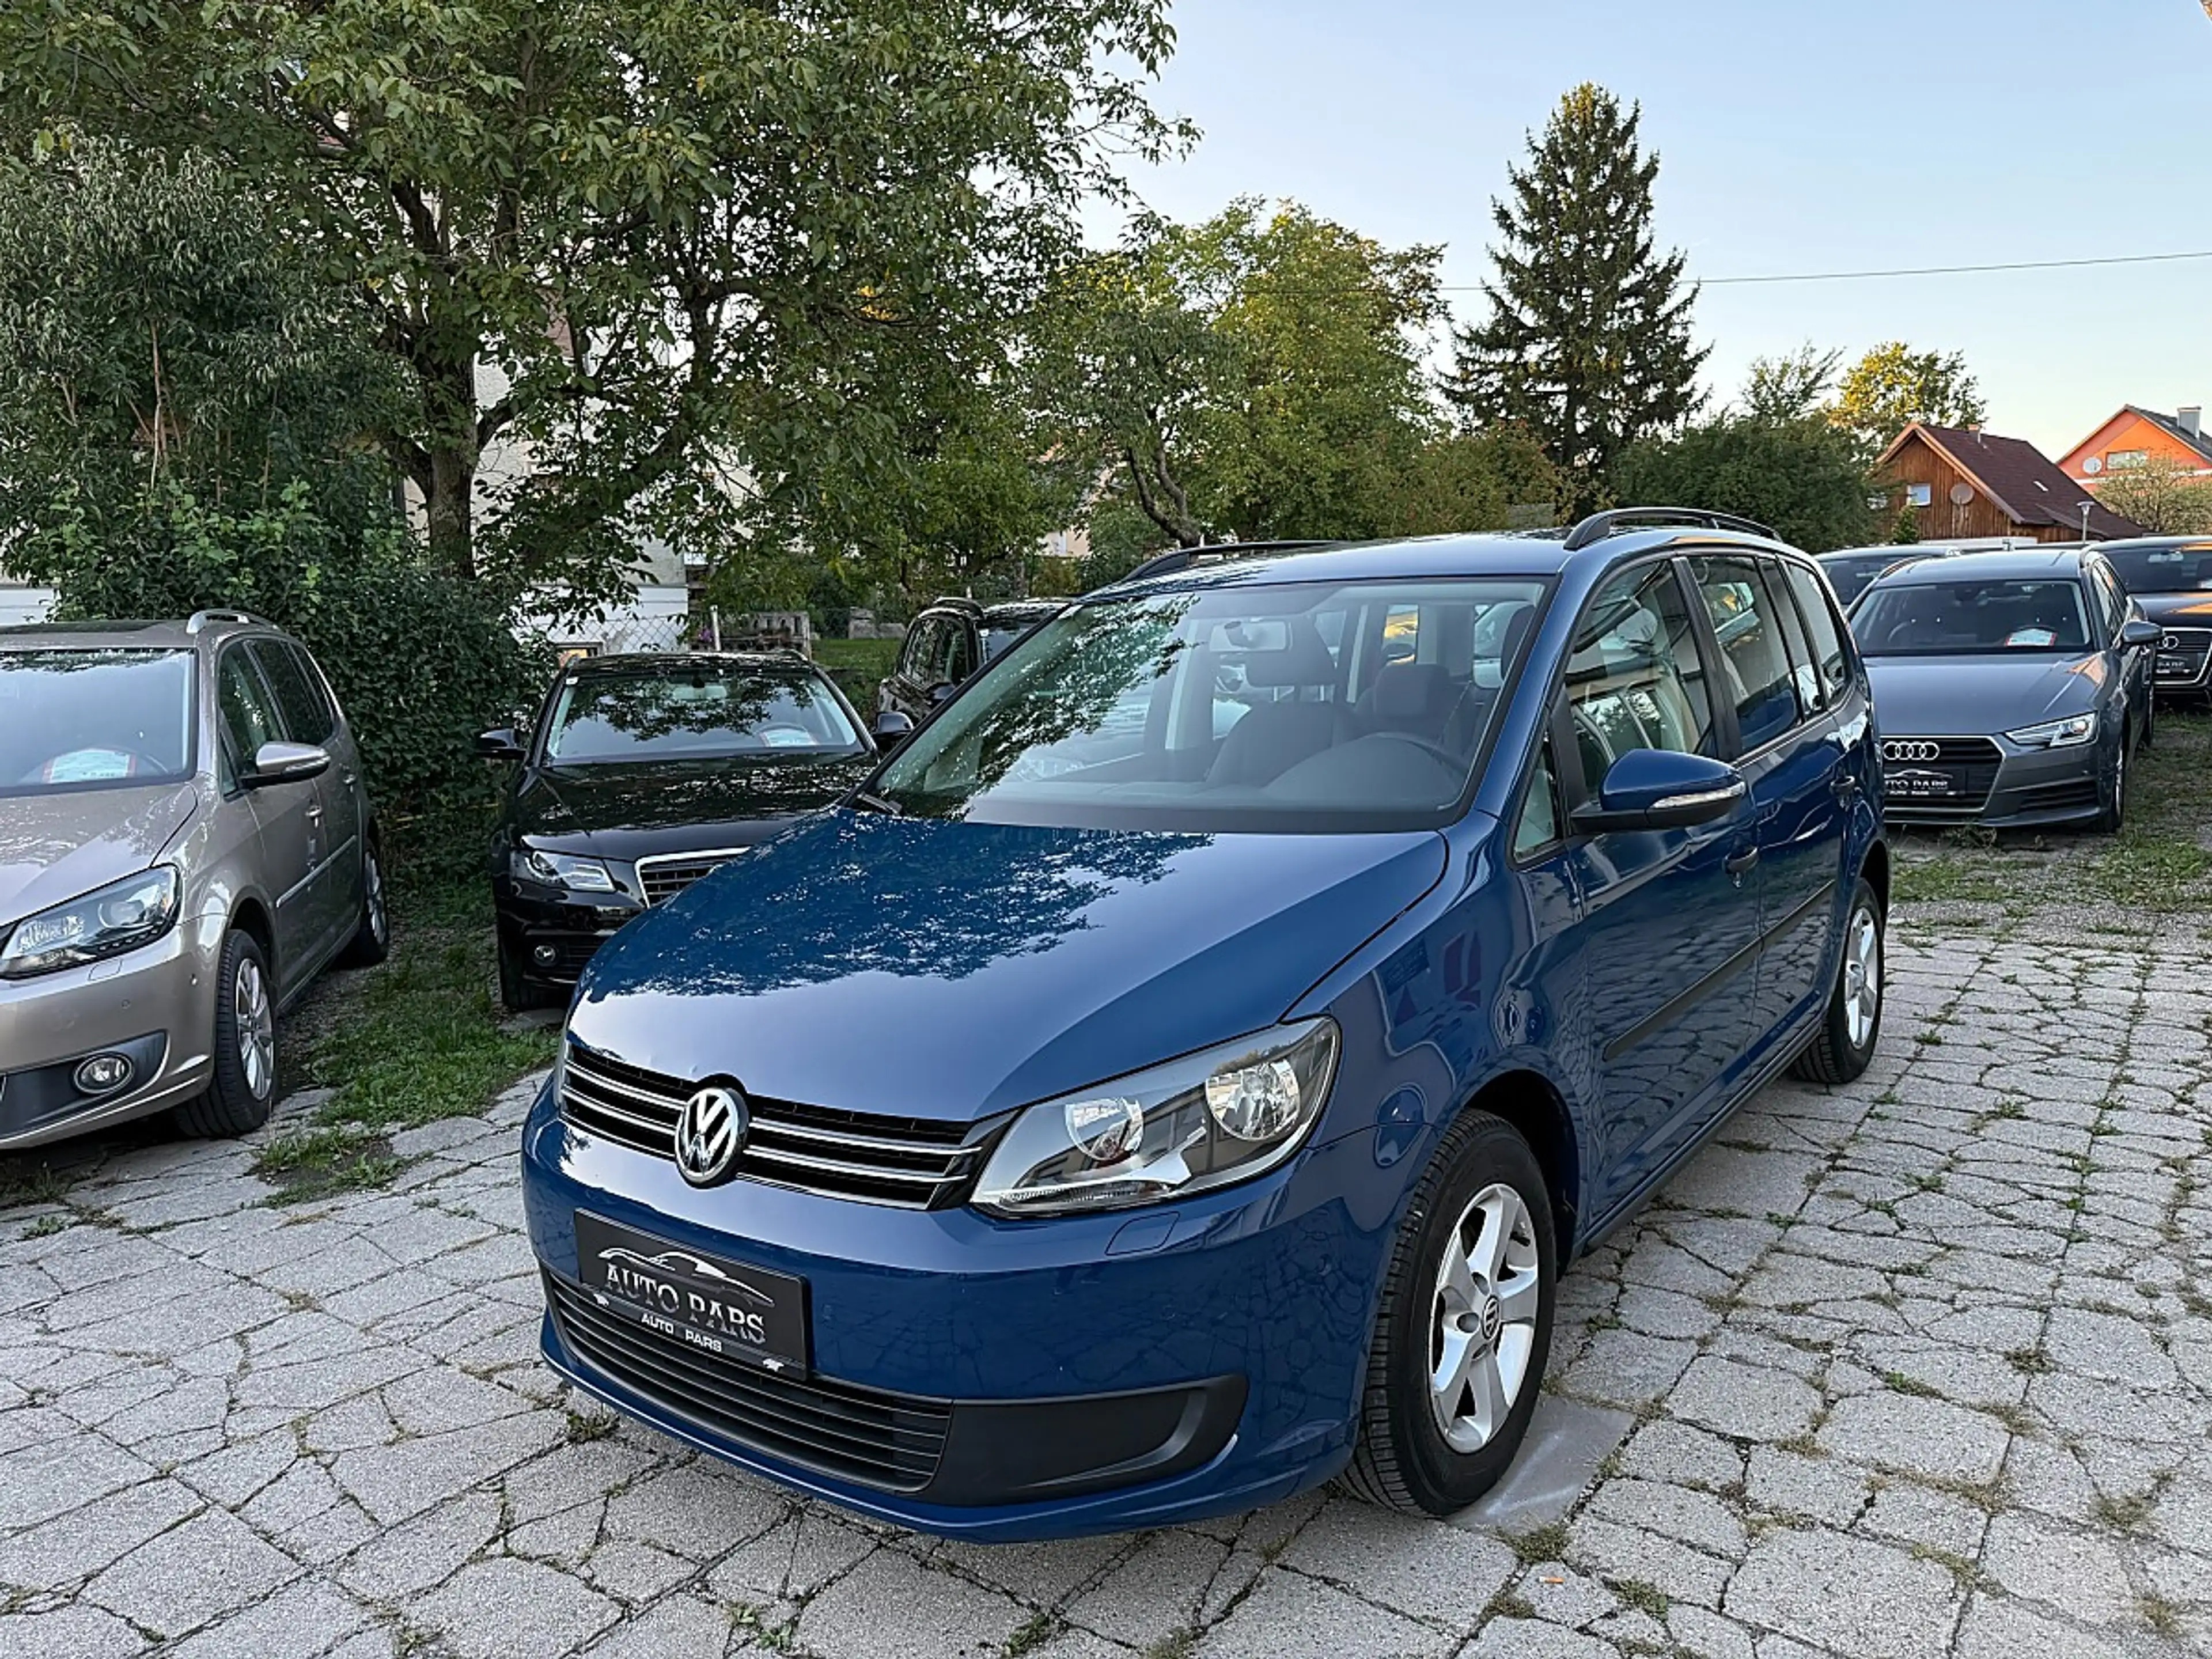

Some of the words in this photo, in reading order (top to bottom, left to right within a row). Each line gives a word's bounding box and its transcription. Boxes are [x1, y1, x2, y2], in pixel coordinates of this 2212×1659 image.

[605, 1263, 679, 1313] AUTO
[687, 1291, 766, 1344] PARS
[641, 1313, 674, 1335] AUTO
[685, 1329, 722, 1352] PARS
